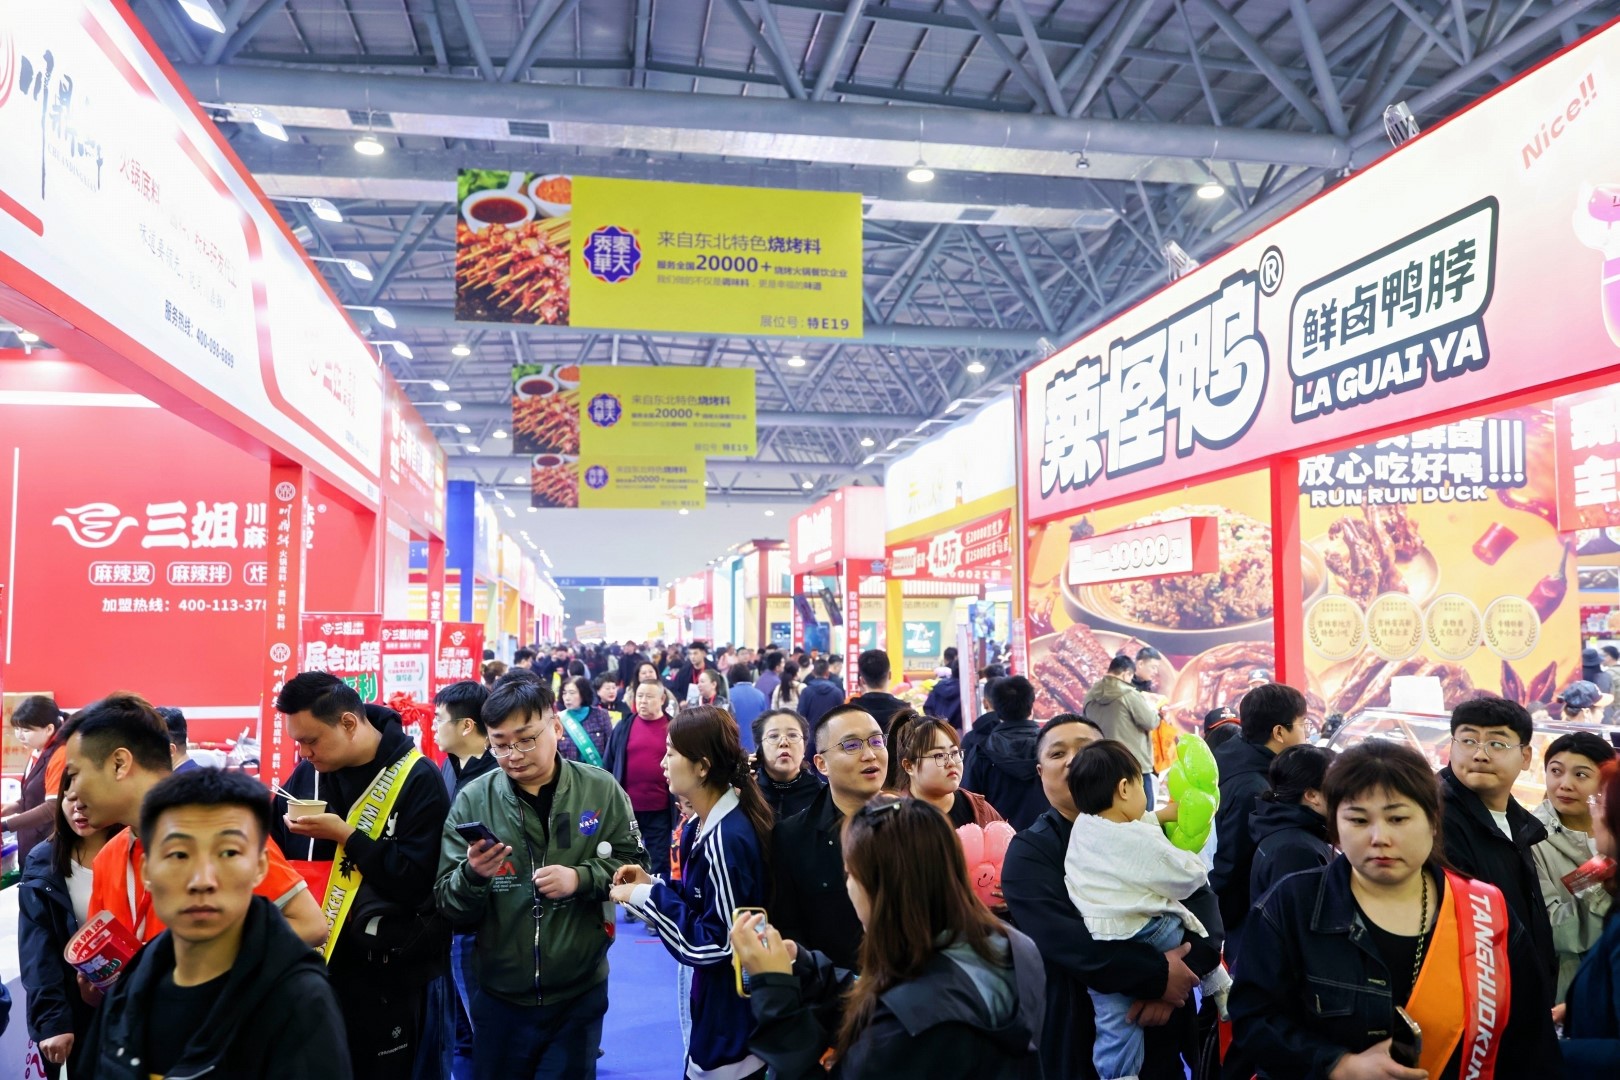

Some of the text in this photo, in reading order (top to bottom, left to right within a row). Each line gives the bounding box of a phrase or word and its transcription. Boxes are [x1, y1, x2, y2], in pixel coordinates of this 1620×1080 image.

[1522, 73, 1597, 170] Nice!!
[658, 230, 821, 255] 来自东北特色烧烤料
[1302, 239, 1476, 357] 鲜卤鸭脖
[1295, 325, 1484, 417] LA GUAI YA
[1298, 452, 1483, 486] 放心吃好鸭
[1311, 485, 1487, 506] RUN RUN DUCK
[141, 500, 237, 549] 三姐
[93, 564, 150, 584] 麻辣烫
[171, 564, 227, 584] 麻辣拌
[304, 640, 381, 672] 展会政策
[579, 818, 599, 829] NASA
